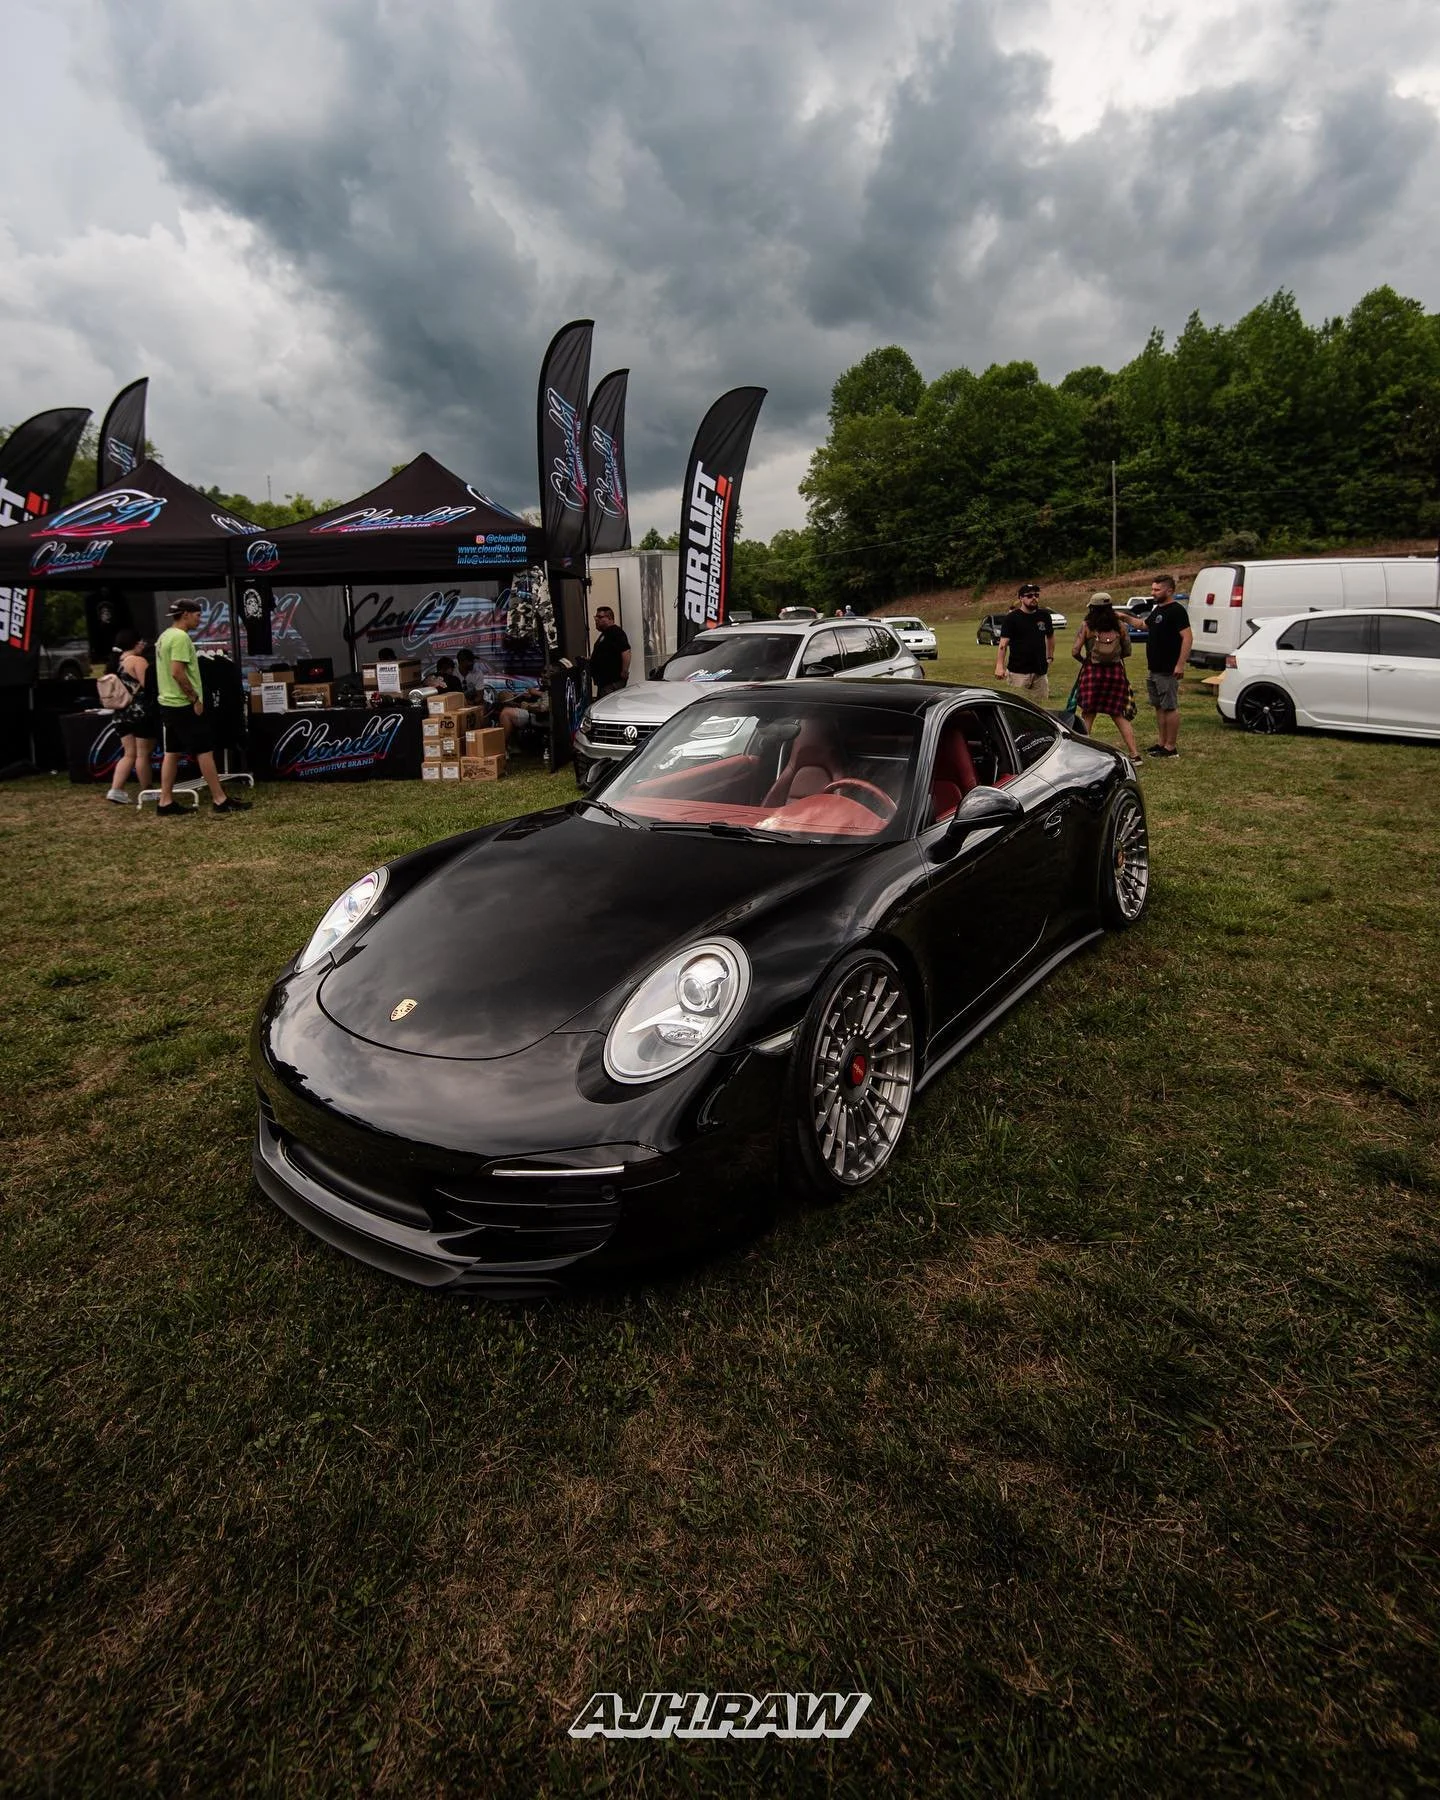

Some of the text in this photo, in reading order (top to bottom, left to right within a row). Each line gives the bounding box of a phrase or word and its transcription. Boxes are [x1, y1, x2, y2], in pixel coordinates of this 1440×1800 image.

[547, 387, 588, 512] Cloud9
[688, 460, 717, 547] LIFT
[29, 540, 113, 576] Cloud9
[270, 713, 404, 775] Cloud9
